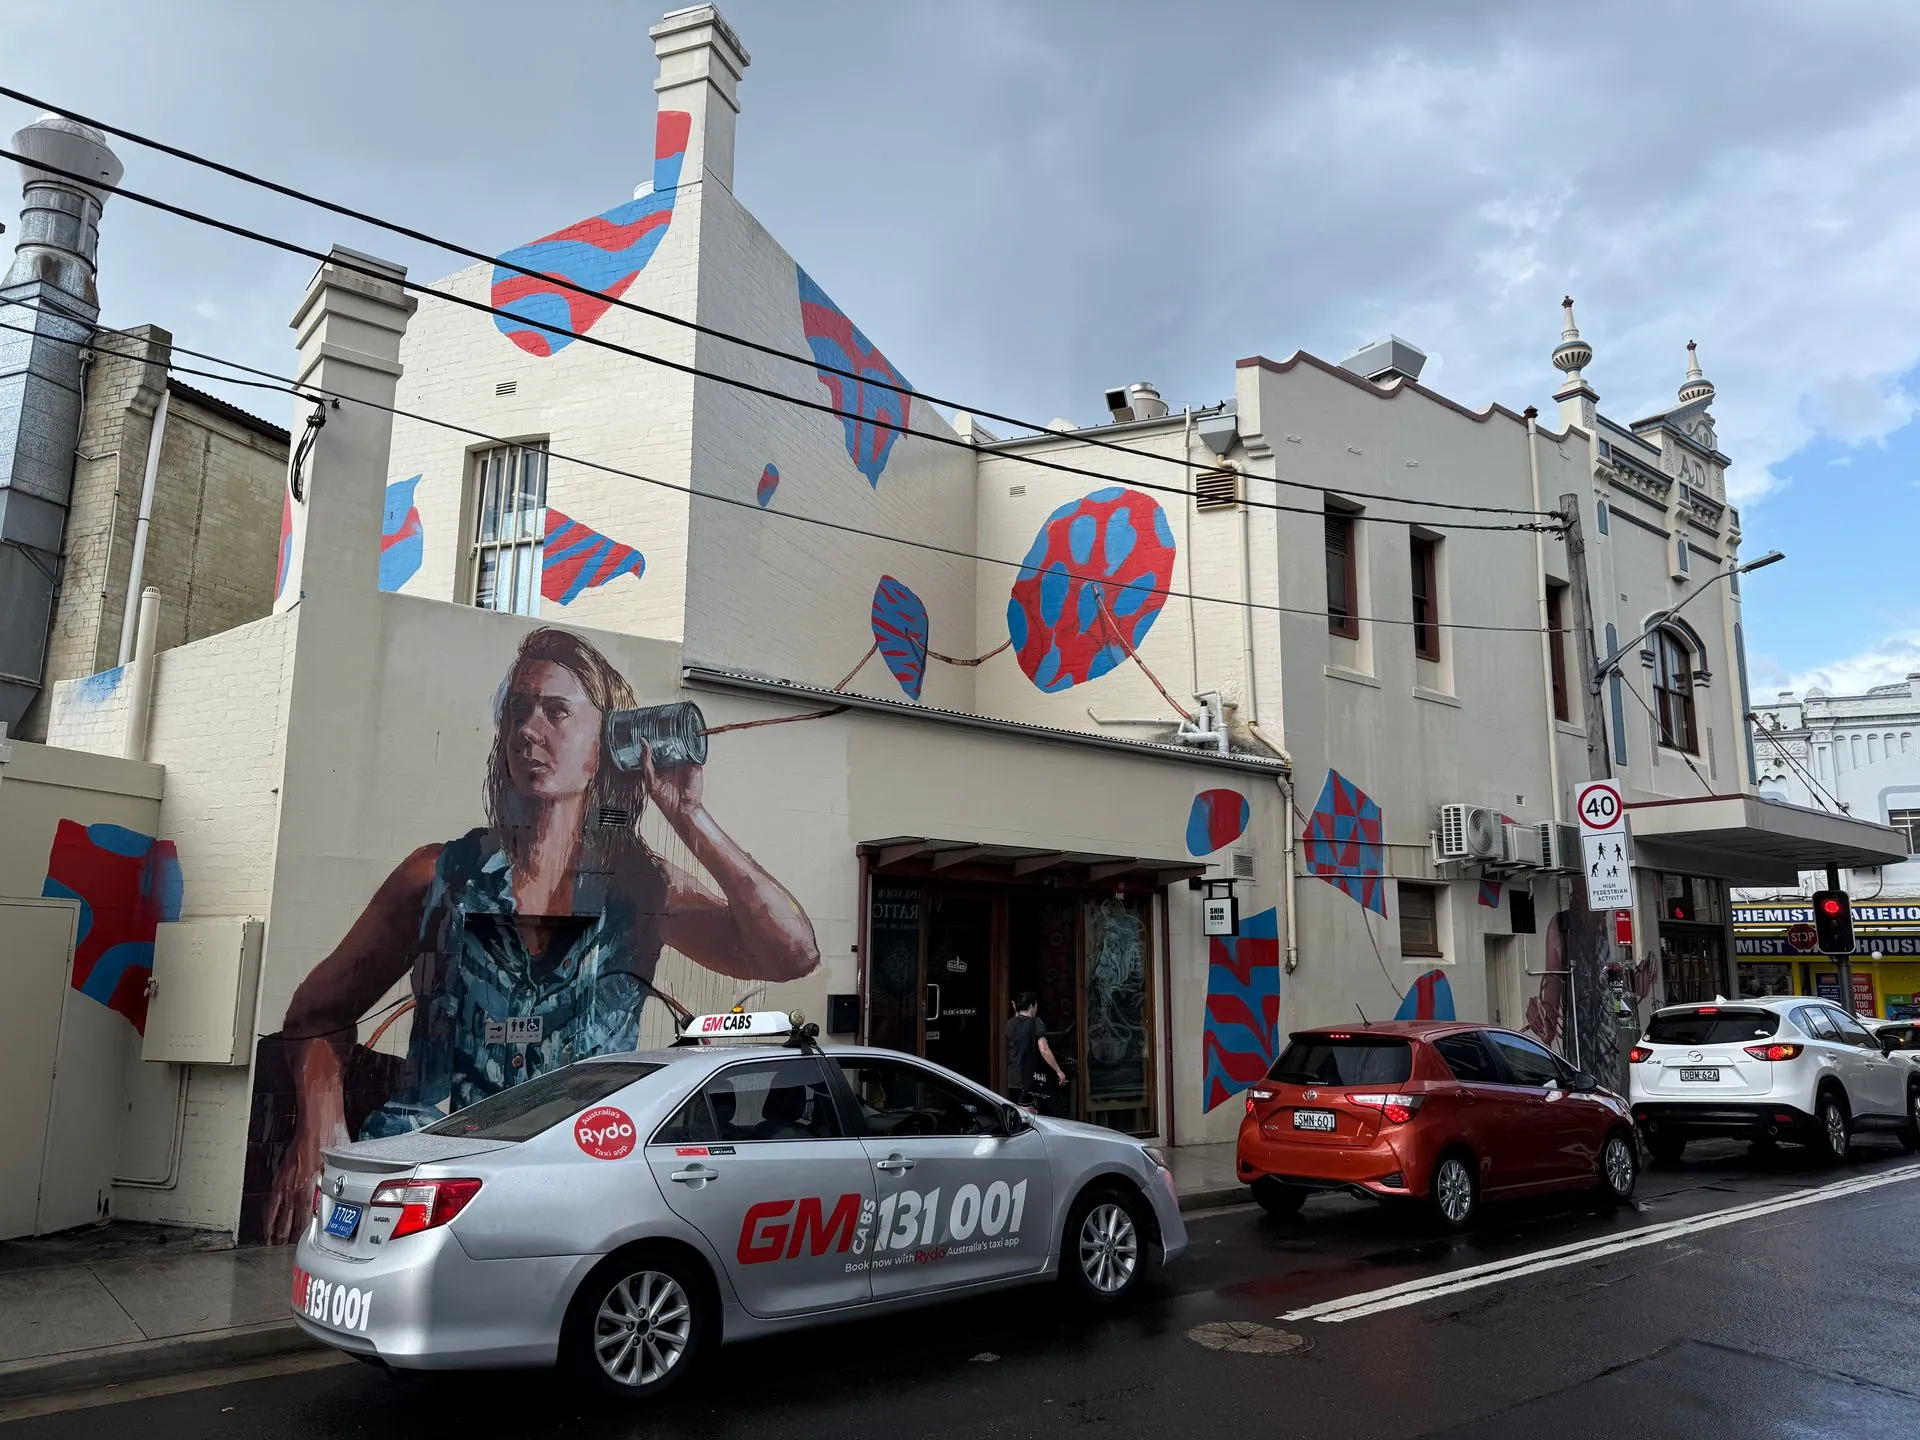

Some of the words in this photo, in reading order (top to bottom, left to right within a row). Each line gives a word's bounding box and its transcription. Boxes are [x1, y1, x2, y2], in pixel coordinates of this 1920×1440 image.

[1585, 795, 1615, 818] 40
[1592, 888, 1628, 896] PEDESTRIAN
[1597, 894, 1624, 902] ACTIVITY
[1790, 931, 1816, 943] STOP
[1852, 985, 1869, 993] STOP
[702, 1016, 724, 1032] GM
[723, 1014, 752, 1031] CABS
[581, 1108, 621, 1126] Australia's
[578, 1121, 632, 1147] Rydo
[594, 1147, 612, 1157] Taxi
[873, 1186, 941, 1252] 131
[949, 1178, 1028, 1240] 001
[736, 1192, 861, 1265] GM
[852, 1199, 877, 1255] CABS
[844, 1260, 870, 1273] Book
[872, 1258, 893, 1269] now
[894, 1253, 915, 1266] with
[915, 1248, 946, 1265] Rydo
[946, 1240, 988, 1256] Australia's
[988, 1239, 1003, 1249] taxi
[1004, 1236, 1020, 1248] app
[310, 1279, 332, 1321] 131
[332, 1284, 374, 1332] 001
